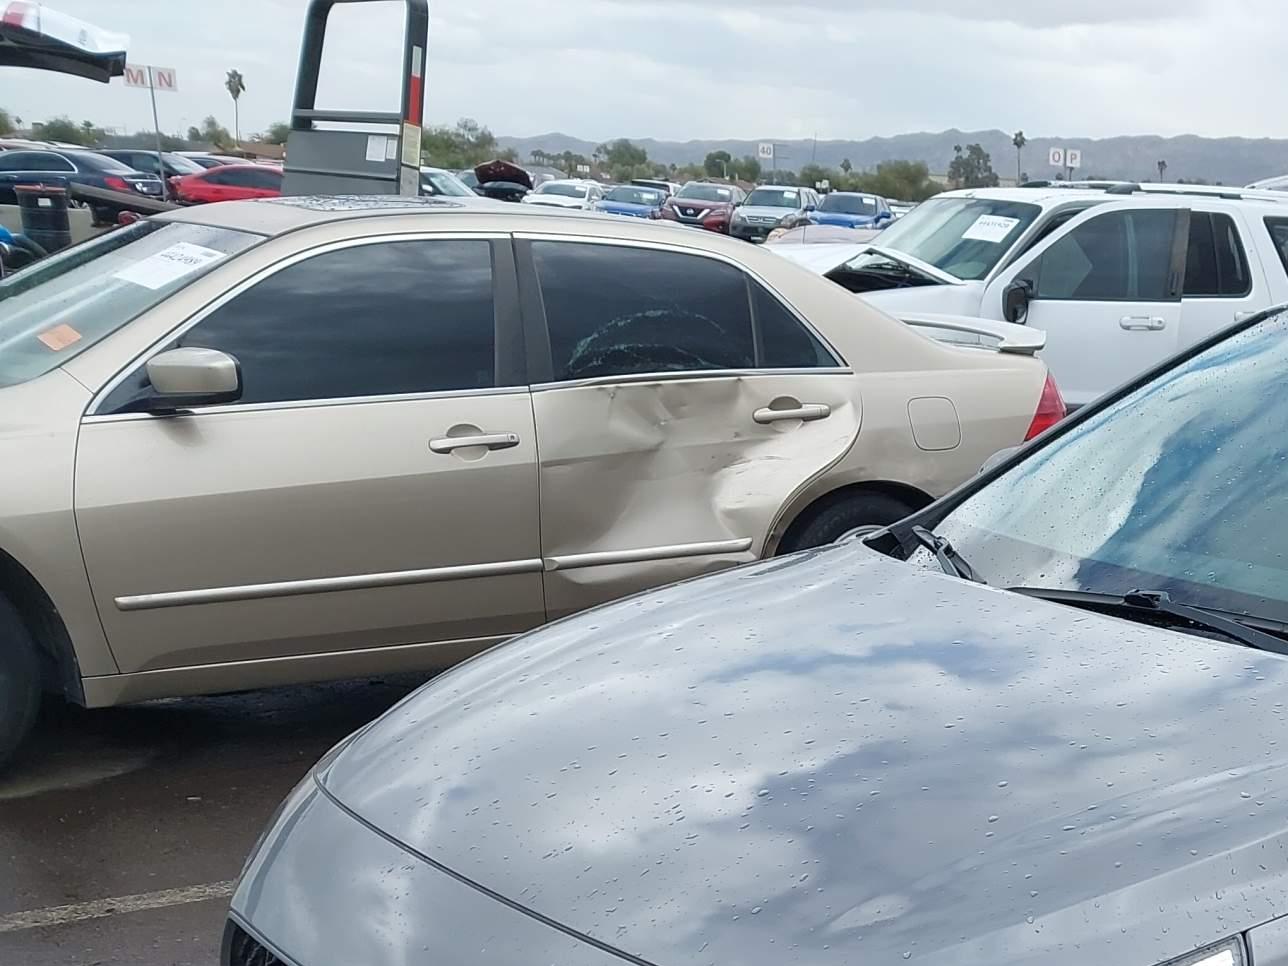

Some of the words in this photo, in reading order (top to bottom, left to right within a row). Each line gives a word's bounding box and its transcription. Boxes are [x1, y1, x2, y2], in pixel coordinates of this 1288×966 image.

[126, 69, 145, 85] M
[157, 71, 173, 88] N
[760, 146, 772, 156] 40
[1070, 153, 1078, 164] P
